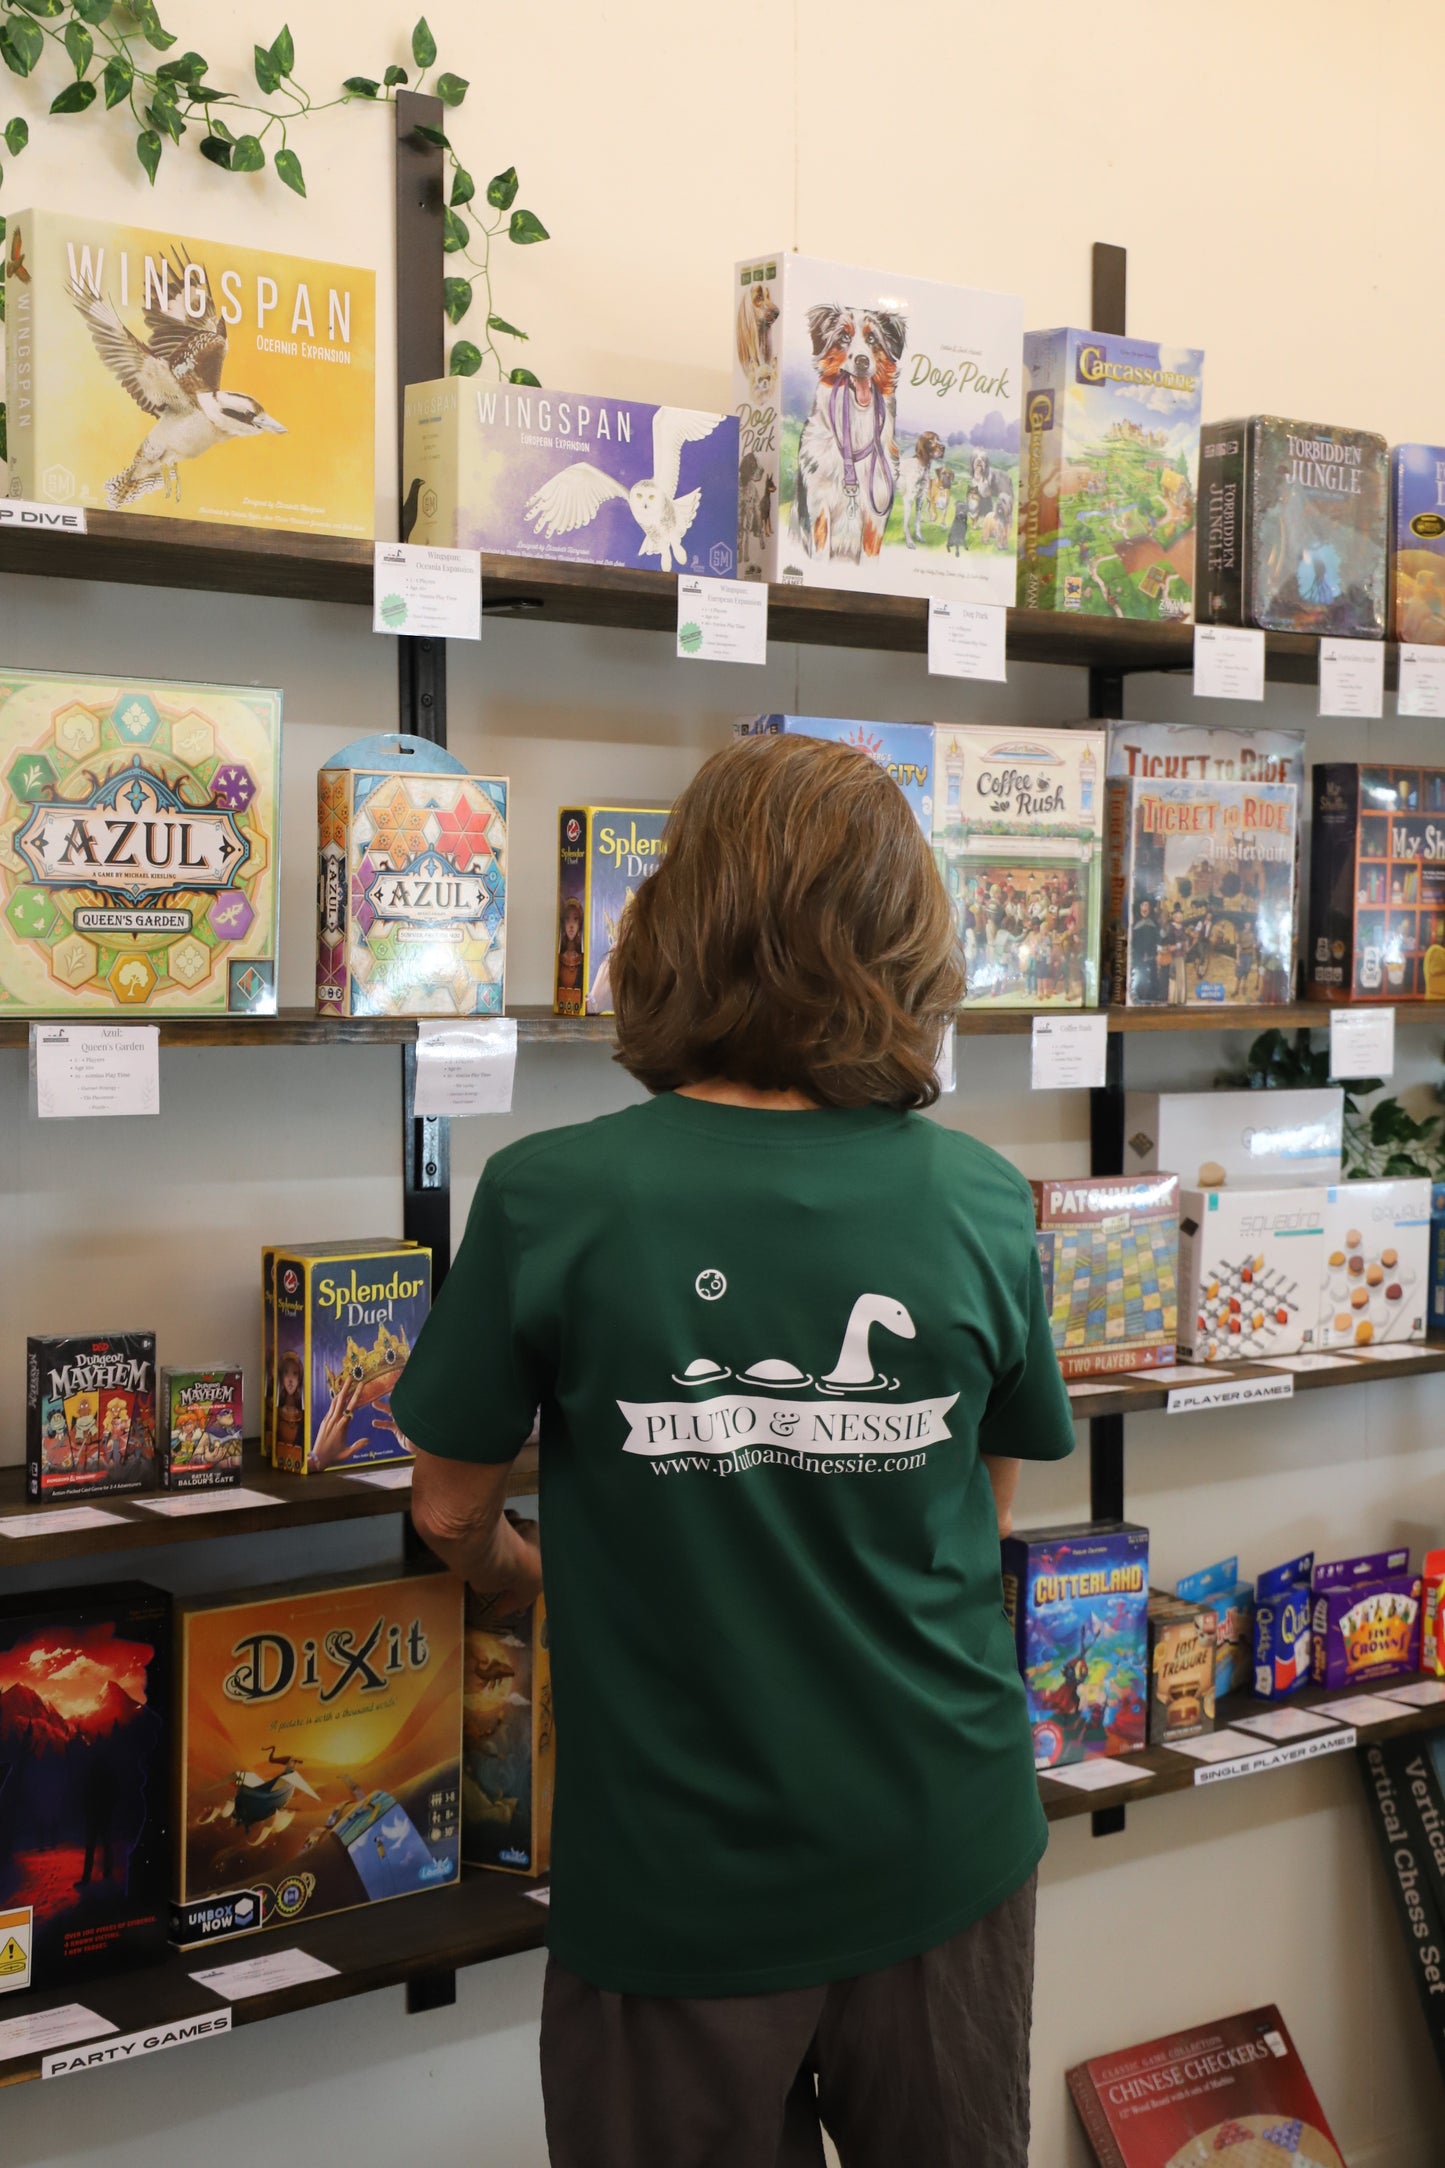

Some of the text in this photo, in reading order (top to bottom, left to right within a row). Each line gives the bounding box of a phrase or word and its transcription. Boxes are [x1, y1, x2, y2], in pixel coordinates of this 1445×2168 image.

[66, 241, 351, 344] WINGSPAN
[18, 292, 32, 429] WINGSPAN
[910, 353, 1010, 399] Dog Park
[1079, 346, 1198, 394] Carcassonne
[476, 390, 633, 444] WINGSPAN
[736, 403, 777, 437] Dog
[742, 429, 777, 455] Park
[1287, 435, 1363, 465] FORBIDDEN
[1285, 459, 1364, 495] JUNGLE
[21, 511, 78, 527] DIVE
[1207, 482, 1223, 573] JUNGLE
[1223, 483, 1237, 569] FORBIDDEN
[886, 762, 929, 788] CITY
[1123, 744, 1211, 780] TICKET
[1240, 748, 1293, 783] RIDE
[976, 769, 1033, 798] Coffee
[1014, 785, 1066, 817] Rush
[1141, 795, 1219, 834] TICKET
[1243, 796, 1292, 835] RIDE
[56, 818, 209, 869] AZUL
[1391, 826, 1422, 859] My
[328, 868, 338, 919] AZUL
[388, 880, 470, 909] AZUL
[82, 914, 185, 927] QUEEN'S GARDEN
[115, 1041, 145, 1051] Garden
[318, 1268, 425, 1320] Splendor
[347, 1299, 394, 1327] Duel
[74, 1352, 124, 1368] Dungeon
[1068, 1357, 1091, 1374] TWO
[1094, 1352, 1136, 1370] PLAYERS
[47, 1358, 151, 1403] MAYHEM
[180, 1385, 235, 1407] MAYHEM
[1172, 1384, 1292, 1408] 2 PLAYER GAMES
[645, 1405, 933, 1444] PLUTO & NESSIE
[650, 1448, 928, 1477] www.plutoandnessie.com
[1034, 1563, 1144, 1607] CUTTERLAND
[1161, 1650, 1208, 1679] TREASURE
[1174, 1636, 1199, 1660] LOST
[1200, 1734, 1355, 1782] SINGLE PLAYER GAMES
[1366, 1742, 1445, 1995] ertical Chess Set
[188, 1904, 233, 1926] UNBOX
[202, 1915, 233, 1934] NOW
[51, 2016, 228, 2076] PARTY GAMES
[1108, 2039, 1270, 2106] CHINESE CHECKERS
